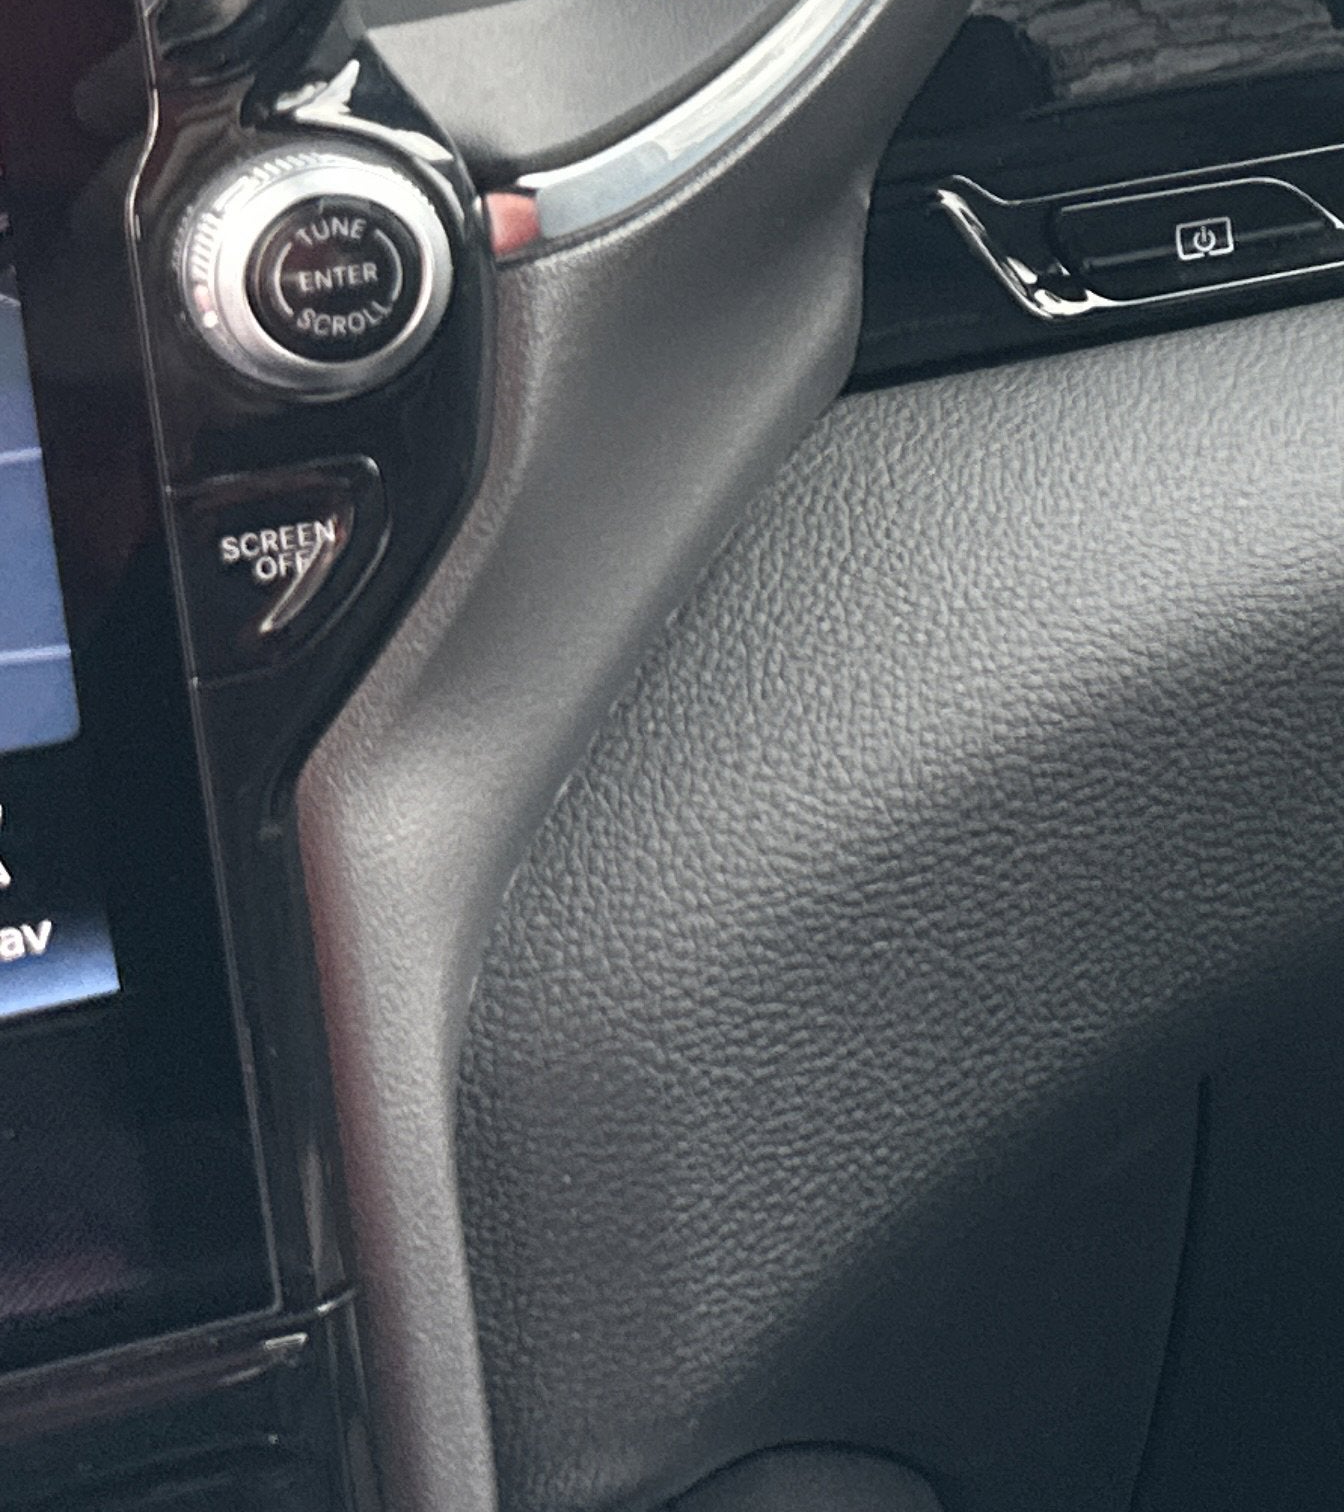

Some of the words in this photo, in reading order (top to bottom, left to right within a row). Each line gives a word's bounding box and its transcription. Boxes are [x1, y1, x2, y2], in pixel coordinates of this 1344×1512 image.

[297, 217, 366, 246] TUNE
[299, 262, 378, 293] ENTER
[296, 300, 393, 338] SCROLL
[221, 519, 336, 562] SCREEN
[255, 550, 312, 580] OFF
